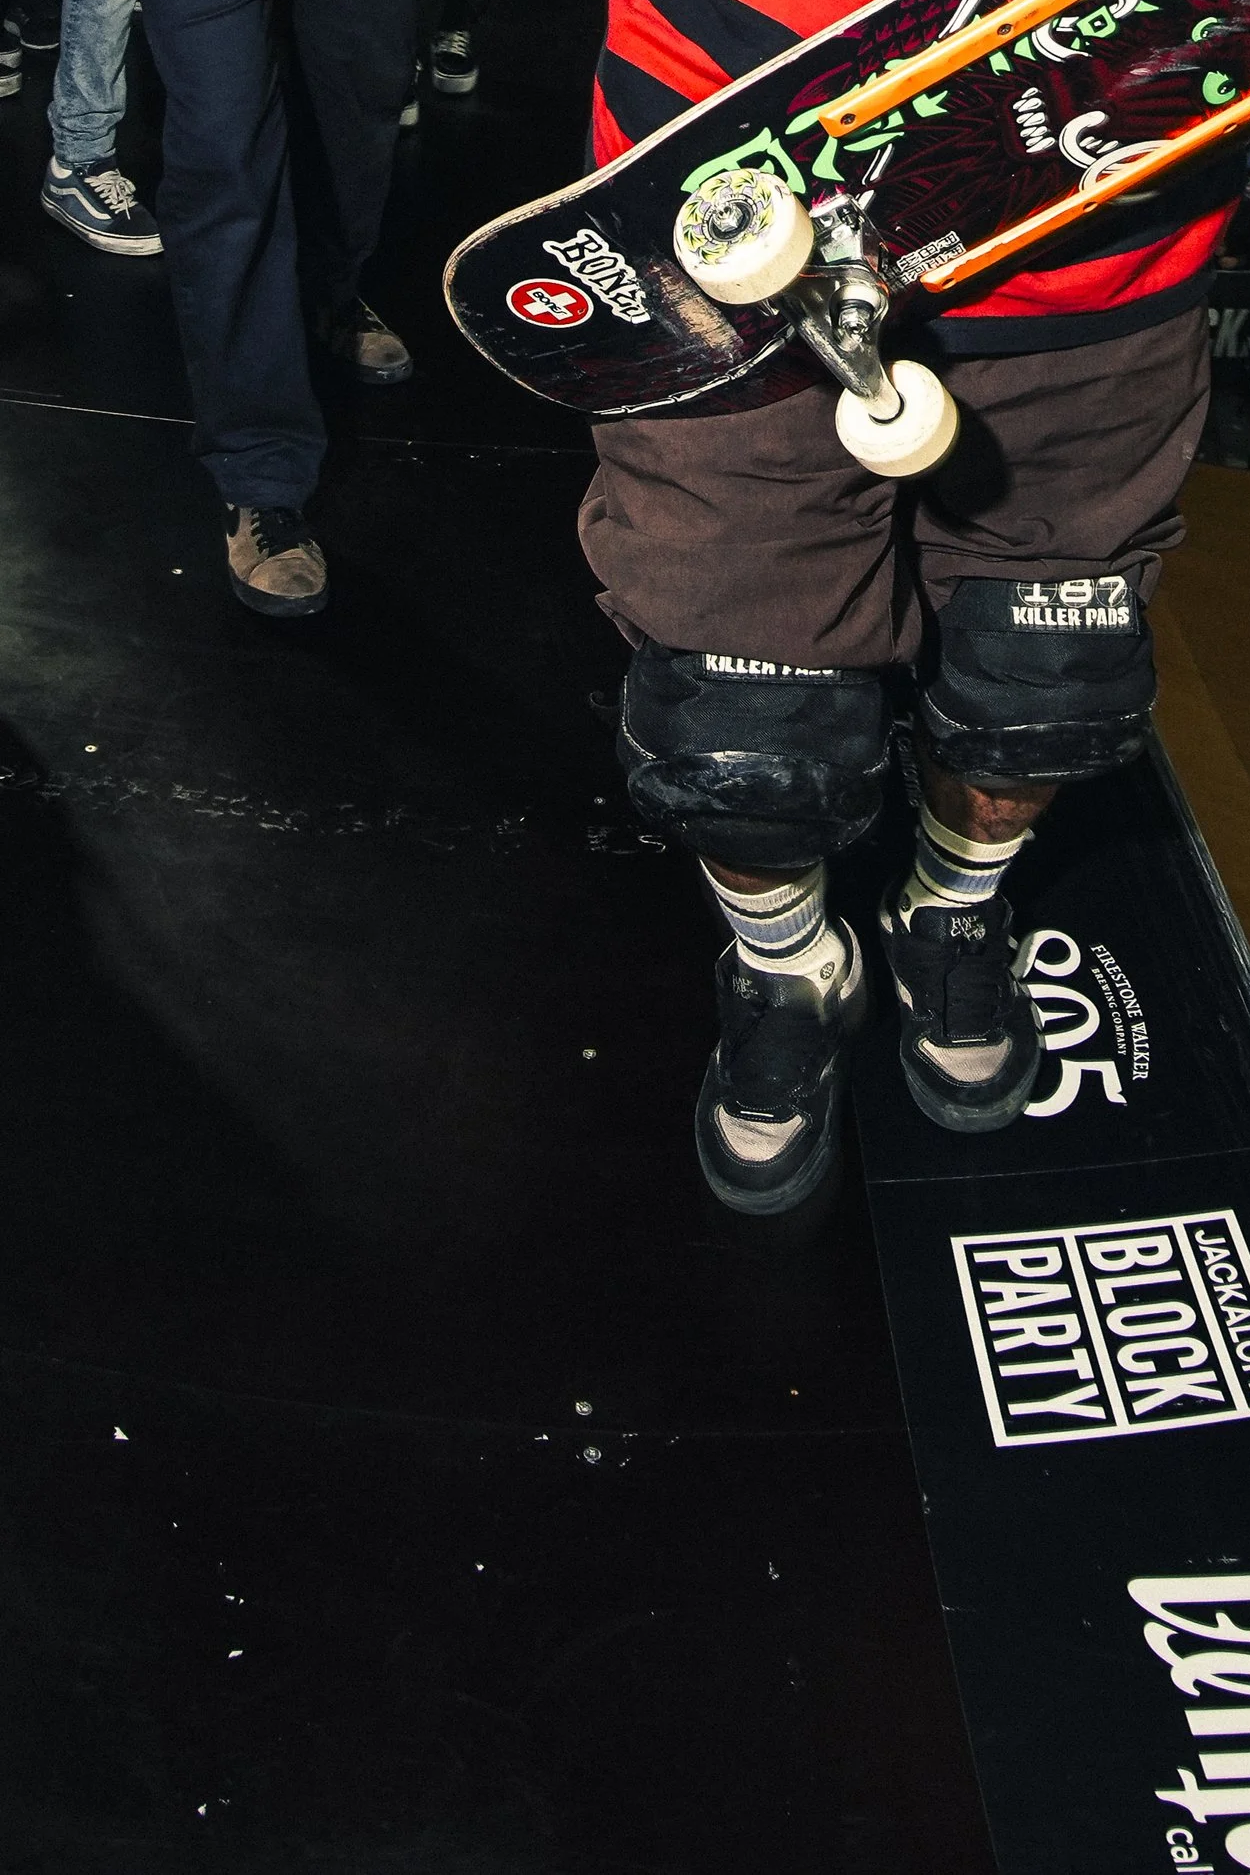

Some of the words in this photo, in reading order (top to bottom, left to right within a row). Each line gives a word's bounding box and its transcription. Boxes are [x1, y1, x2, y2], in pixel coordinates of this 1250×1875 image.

[1011, 606, 1081, 626] KILLER
[1085, 606, 1130, 626] PADS
[1023, 575, 1127, 604] 187
[1090, 966, 1118, 1009] BREWING
[1111, 1011, 1127, 1056] COMPANY
[1090, 944, 1143, 1018] FIRESTONE
[1131, 1021, 1150, 1081] WALKER
[972, 1245, 1107, 1420] PARTY
[1085, 1234, 1226, 1416] BLOCK
[1165, 1827, 1215, 1875] cal
